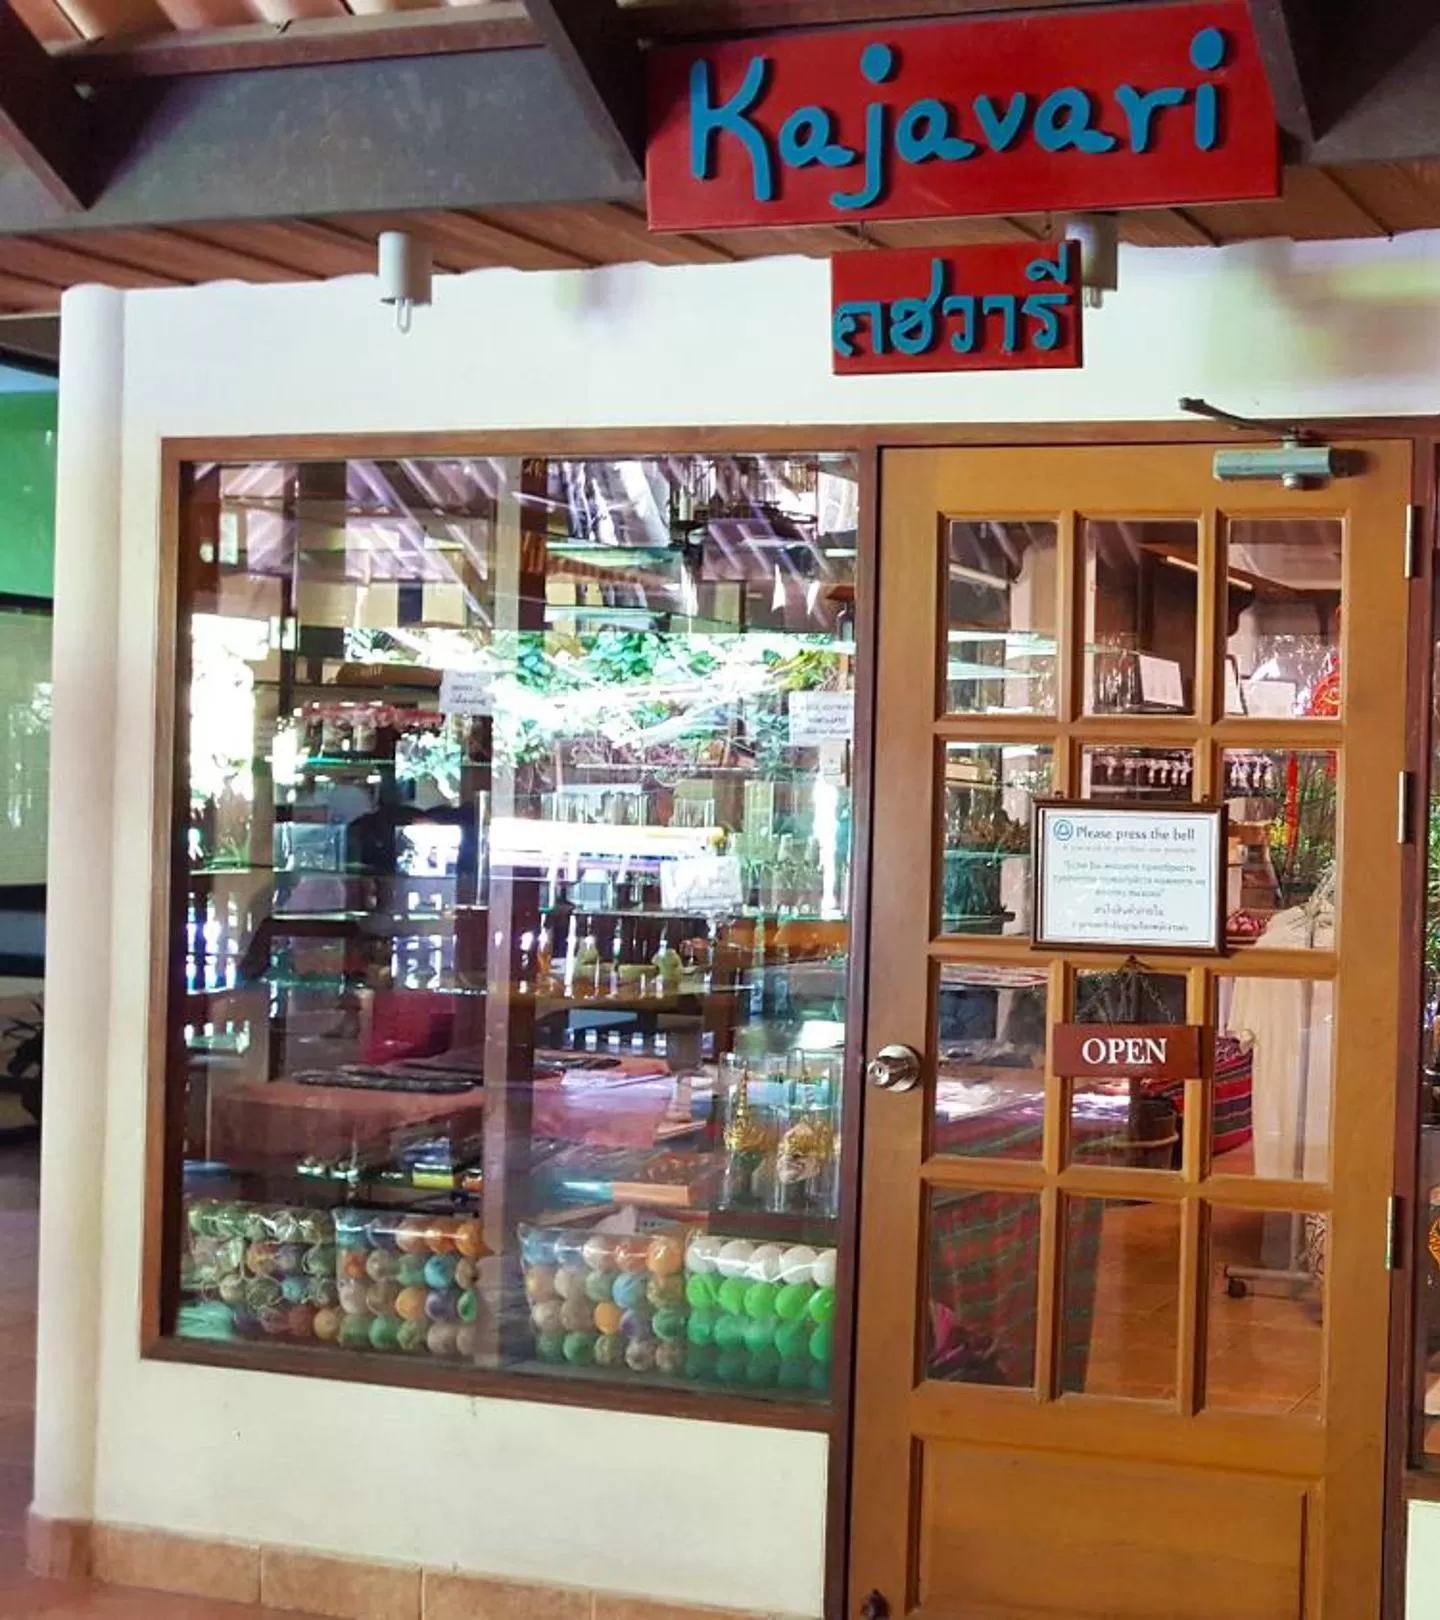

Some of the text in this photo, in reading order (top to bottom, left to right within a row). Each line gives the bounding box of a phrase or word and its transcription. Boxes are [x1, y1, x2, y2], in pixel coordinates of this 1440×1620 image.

[689, 27, 1227, 209] Kajavari
[1075, 825, 1196, 842] Please press the bell
[1081, 1037, 1168, 1065] OPEN
